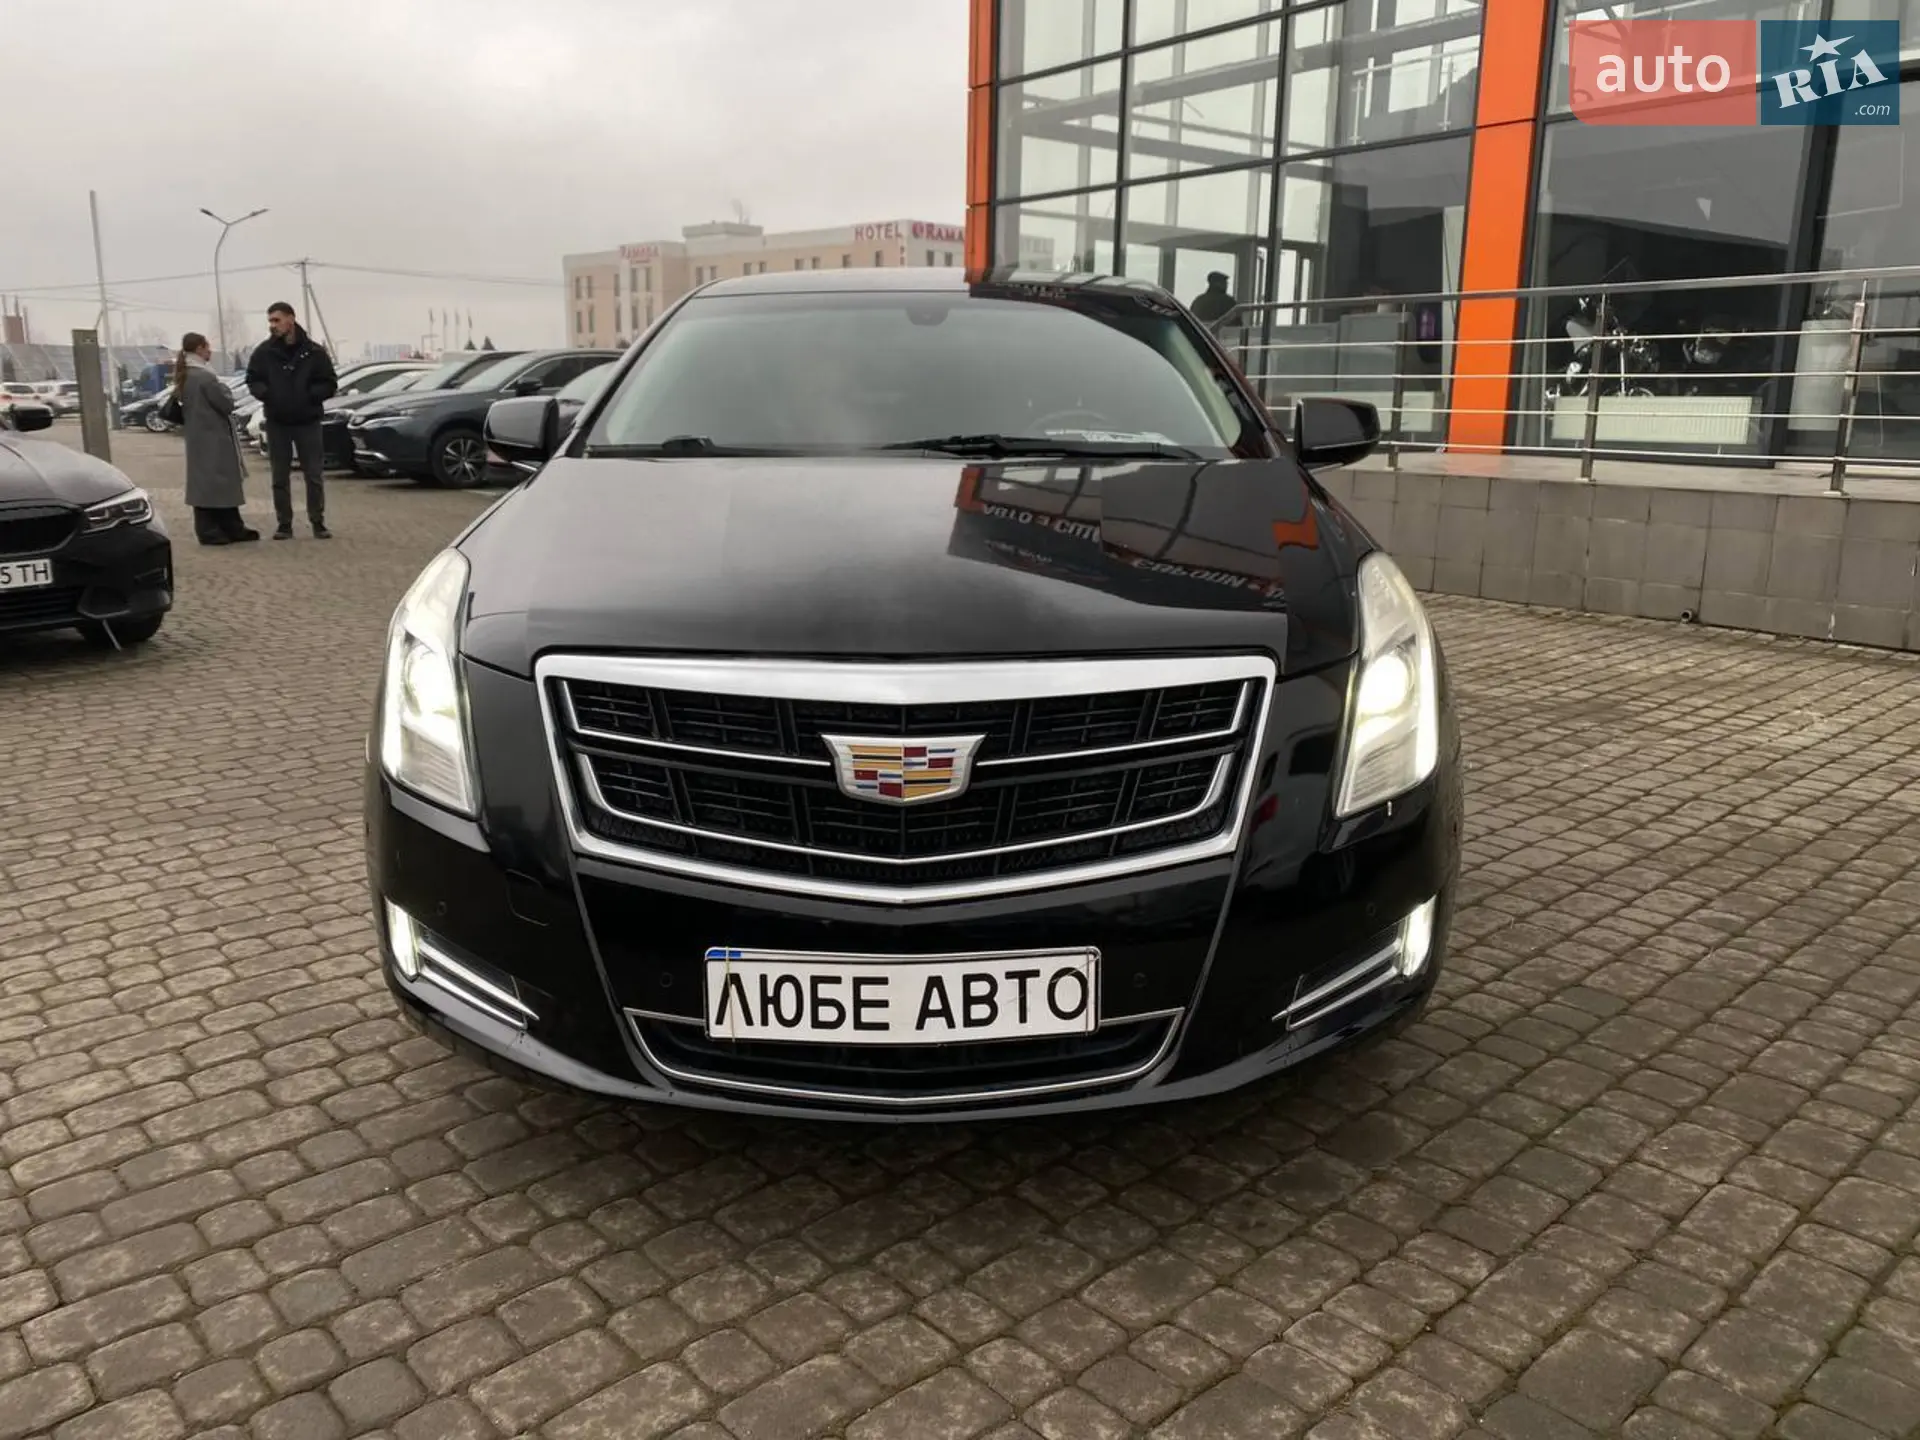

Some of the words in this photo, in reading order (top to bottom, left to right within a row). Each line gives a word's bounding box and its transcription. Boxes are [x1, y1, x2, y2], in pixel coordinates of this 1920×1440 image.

[855, 222, 903, 241] HOTEL
[16, 562, 49, 584] TH
[714, 972, 891, 1031] ЛЮБЕ
[915, 967, 1089, 1031] АВТО
